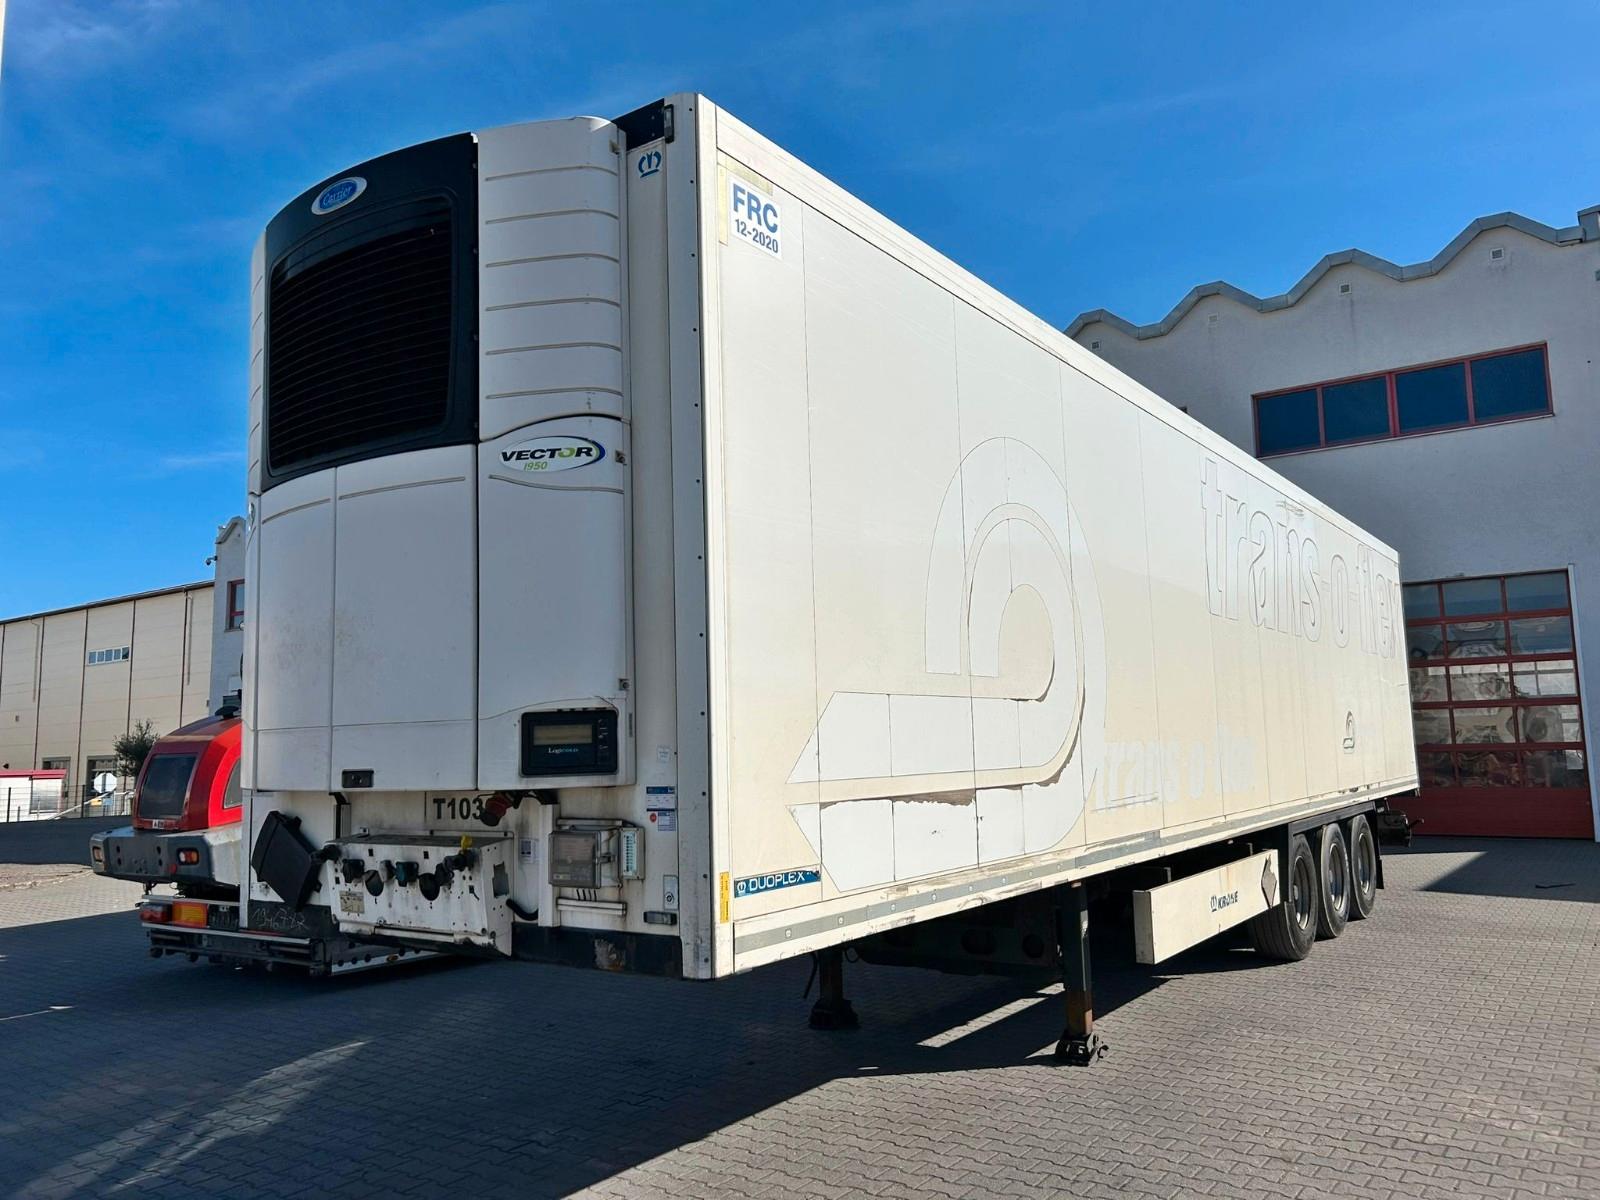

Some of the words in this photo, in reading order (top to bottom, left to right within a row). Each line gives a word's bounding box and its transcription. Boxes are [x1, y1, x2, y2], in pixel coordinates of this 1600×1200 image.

[733, 183, 779, 234] FRC
[735, 218, 779, 254] 12-2020
[501, 446, 594, 462] VECTOR
[523, 461, 549, 472] 1950
[433, 797, 483, 820] T103
[749, 871, 806, 892] DUOPLEX
